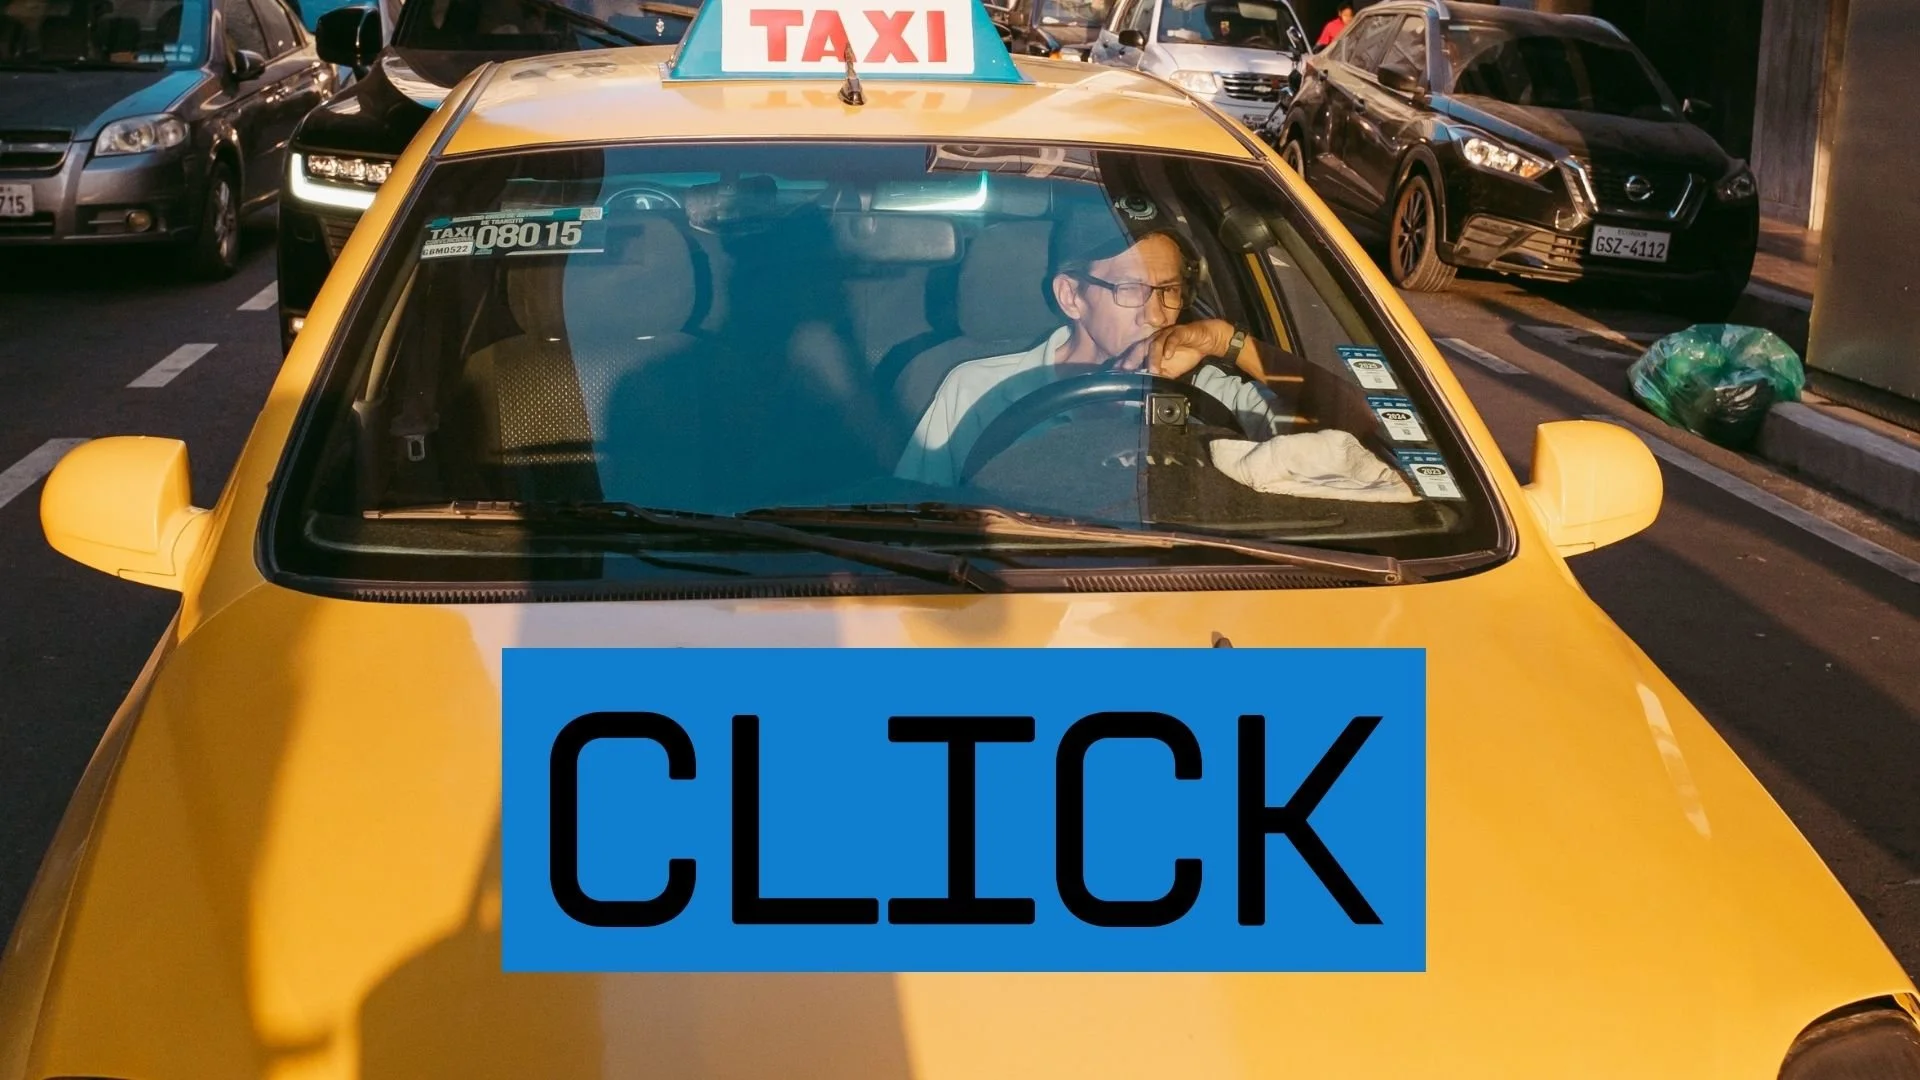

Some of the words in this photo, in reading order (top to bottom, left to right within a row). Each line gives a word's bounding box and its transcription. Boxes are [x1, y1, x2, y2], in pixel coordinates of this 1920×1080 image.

[750, 9, 947, 63] TAXI
[430, 226, 474, 240] TAXI
[475, 220, 582, 249] 08015
[422, 245, 468, 256] GBM0522
[1596, 236, 1665, 259] GSZ-4112
[1387, 412, 1407, 420] 2024
[1421, 467, 1442, 475] 2023
